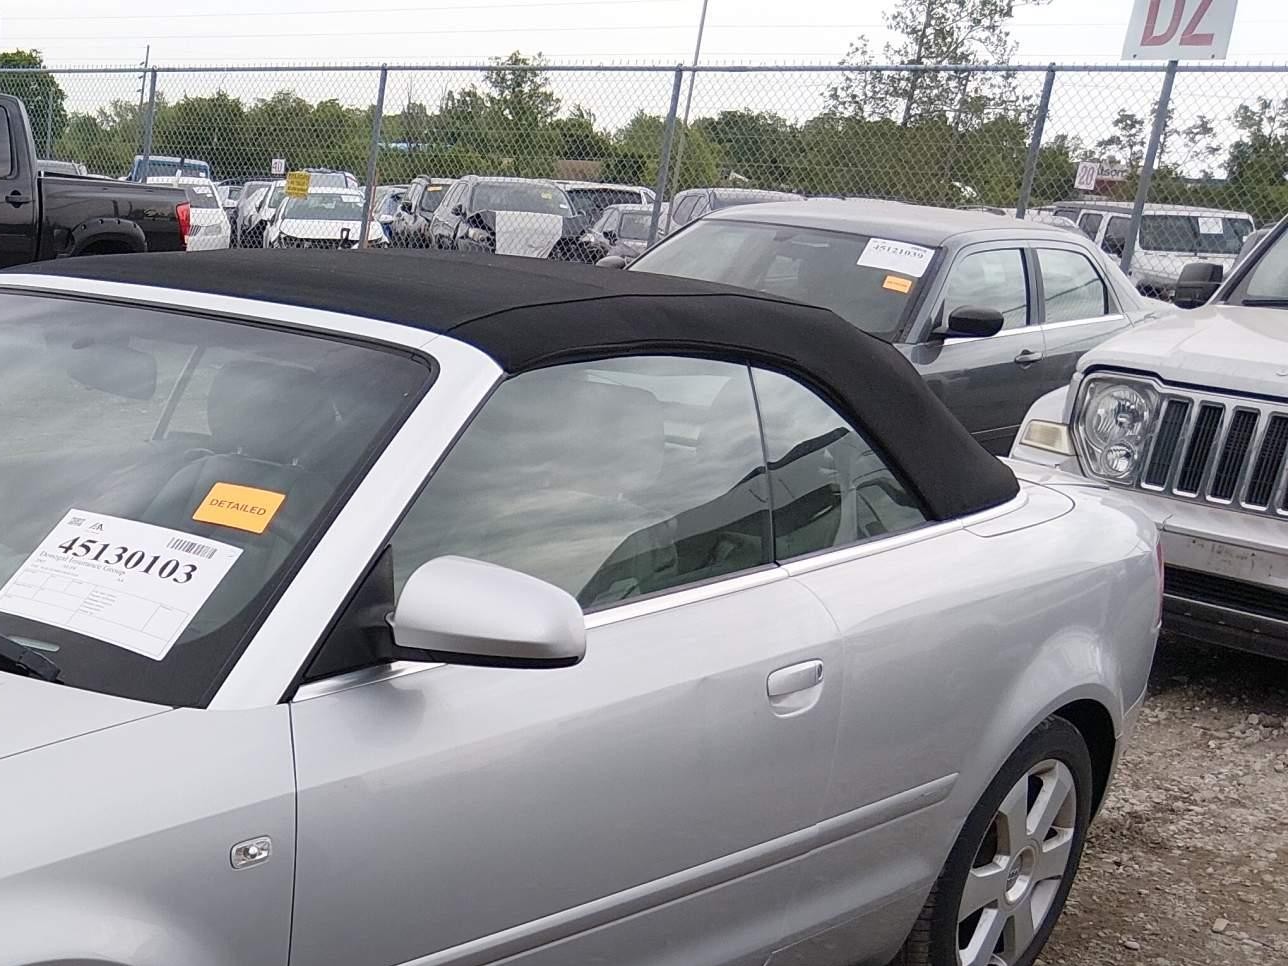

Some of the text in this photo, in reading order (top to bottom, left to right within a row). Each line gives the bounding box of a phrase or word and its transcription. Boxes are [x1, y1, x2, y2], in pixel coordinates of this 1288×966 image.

[1078, 165, 1095, 186] 20
[209, 498, 267, 516] DETAILED
[58, 536, 197, 583] 45130103
